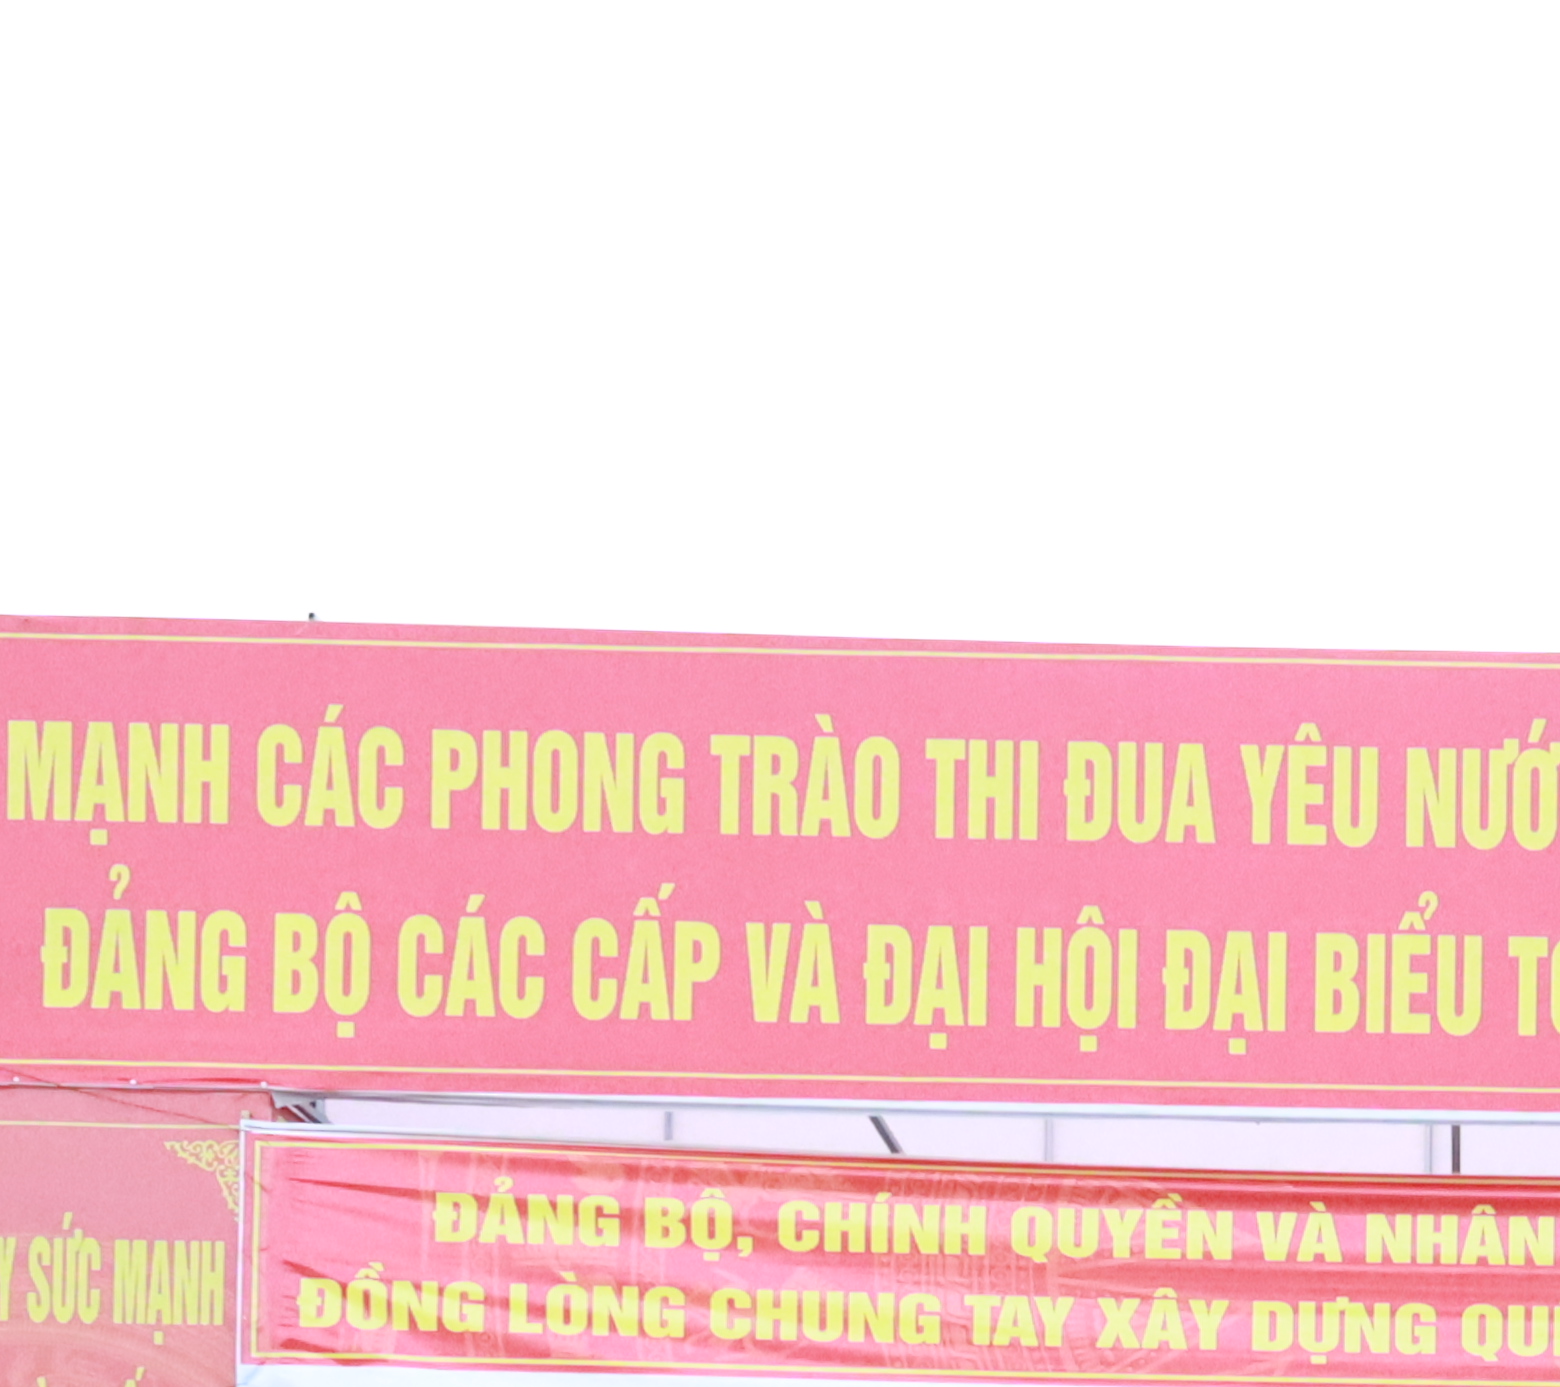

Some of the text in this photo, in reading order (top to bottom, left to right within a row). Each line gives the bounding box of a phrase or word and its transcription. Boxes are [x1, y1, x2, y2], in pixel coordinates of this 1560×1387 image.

[8, 721, 229, 844] MẠNH
[258, 705, 403, 827] CÁC
[432, 730, 684, 833] PHONG
[712, 715, 899, 837] TRÀO
[927, 740, 1038, 839] THI
[1065, 742, 1214, 842] ĐUA
[1242, 724, 1378, 846] YÊU
[42, 866, 246, 1011] ĐẢNG
[274, 893, 370, 1036] BỘ
[399, 896, 545, 1017] CÁC
[573, 885, 720, 1020] CẤP
[747, 902, 840, 1022] VÀ
[864, 925, 988, 1048] ĐẠI
[1016, 907, 1137, 1051] HỘI
[1164, 931, 1286, 1053] ĐẠI
[1316, 892, 1482, 1035] BIỂU
[28, 1214, 101, 1322] SỨC
[114, 1240, 224, 1343] MẠNH
[435, 1178, 620, 1245] ĐẢNG
[645, 1189, 753, 1260] BỘ,
[779, 1193, 986, 1254] CHÍNH
[1012, 1194, 1232, 1262] QUYỀN
[1259, 1202, 1342, 1262] VÀ
[1367, 1206, 1554, 1265] NHÂN
[299, 1263, 484, 1332] ĐỒNG
[510, 1273, 685, 1337] LÒNG
[711, 1289, 940, 1343] CHUNG
[966, 1296, 1072, 1346] TAY
[1098, 1288, 1229, 1349] XÂY
[1253, 1298, 1436, 1363] DỰNG
